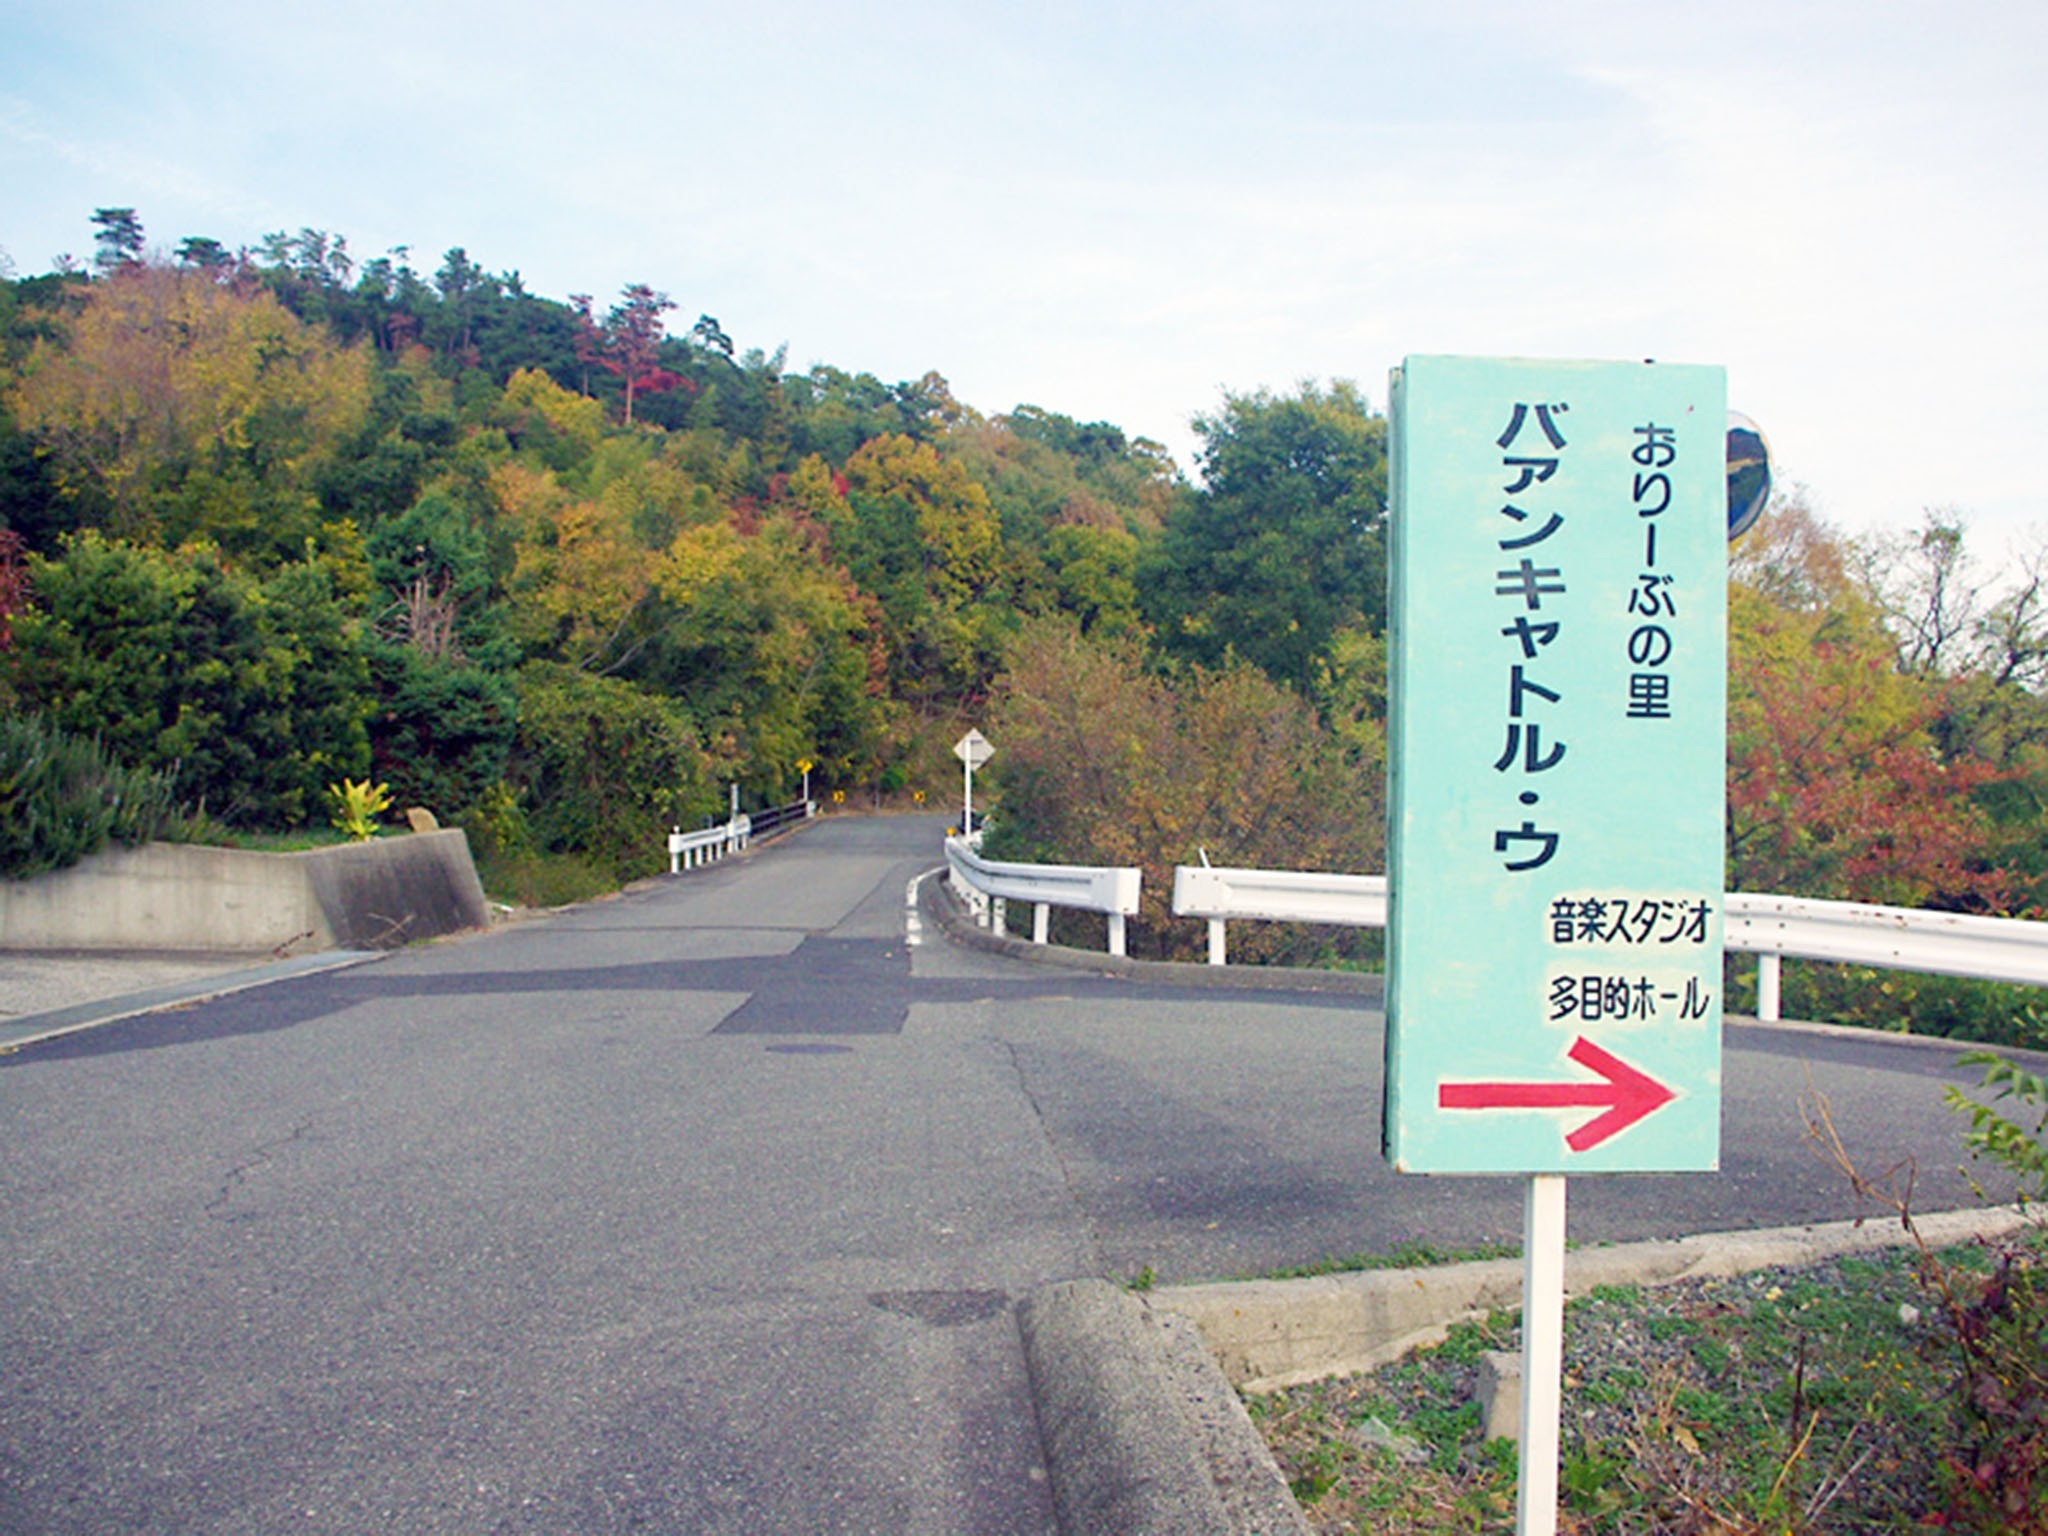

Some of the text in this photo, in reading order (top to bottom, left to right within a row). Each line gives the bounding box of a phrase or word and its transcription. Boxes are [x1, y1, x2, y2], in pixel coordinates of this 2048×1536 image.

[1626, 422, 1676, 719] おりーぶの里
[1550, 897, 1713, 944] 音楽スタジオ
[1548, 975, 1710, 1021] 多目的ホール
